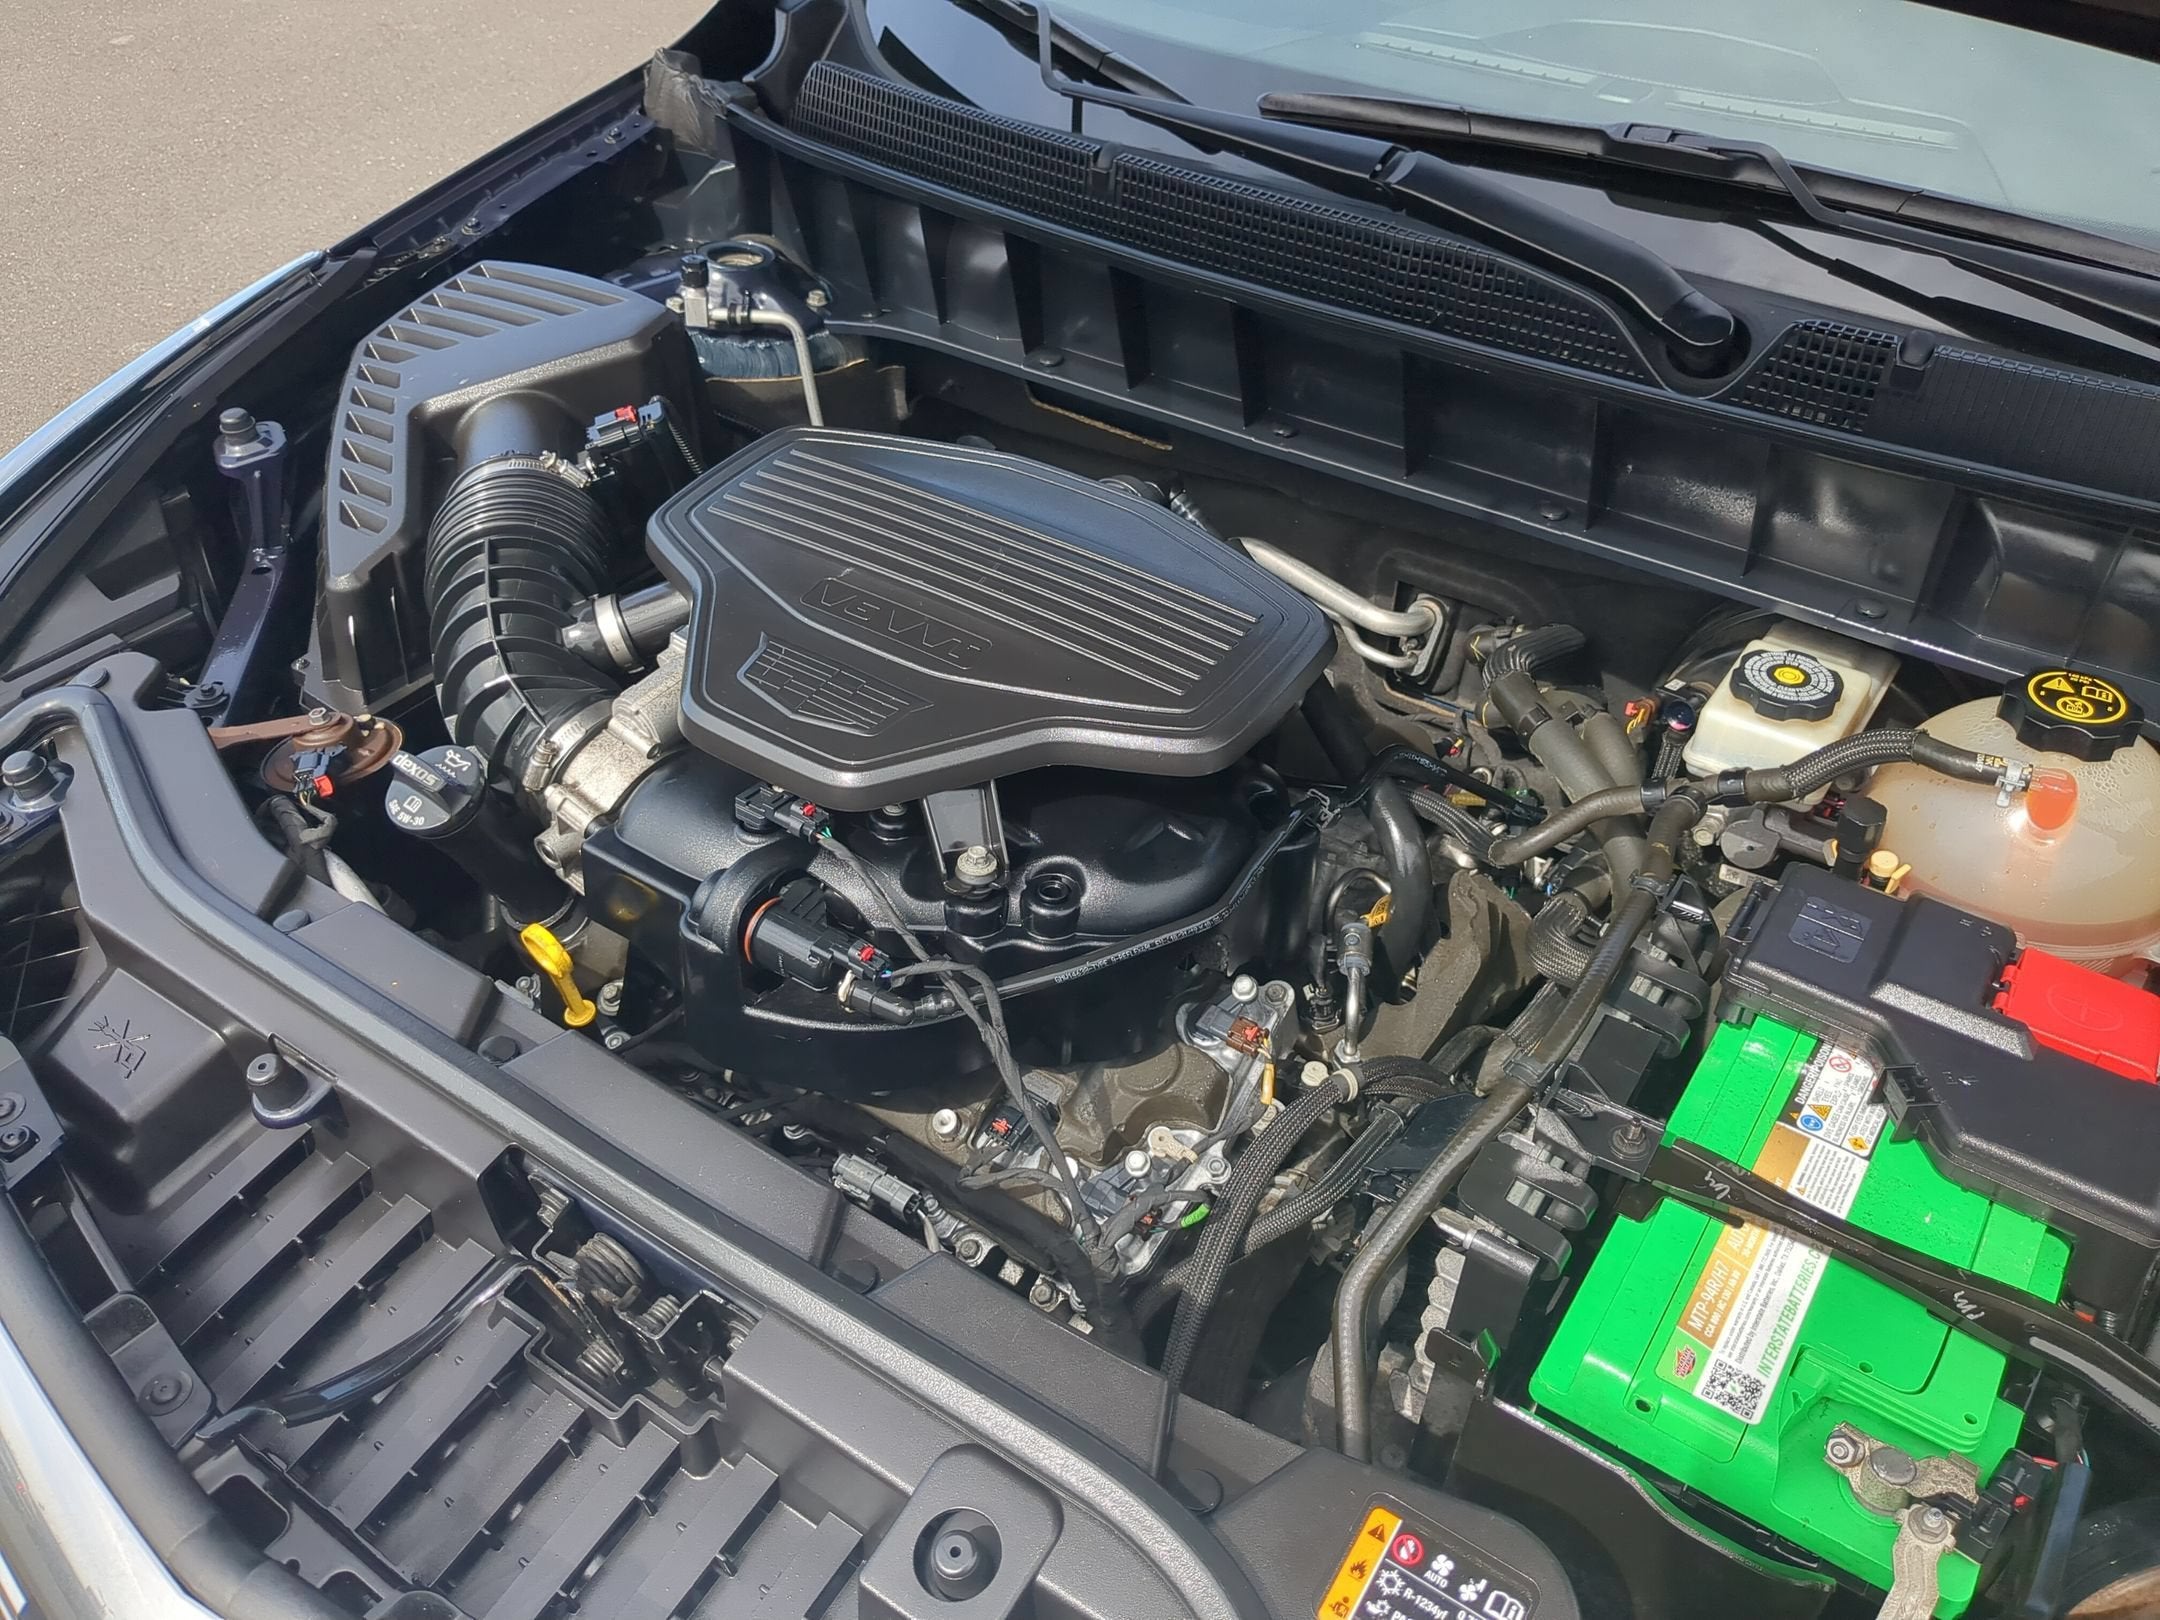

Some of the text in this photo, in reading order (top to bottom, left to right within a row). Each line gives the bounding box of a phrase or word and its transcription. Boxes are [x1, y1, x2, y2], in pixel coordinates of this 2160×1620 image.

[392, 754, 439, 786] dexos
[397, 811, 425, 825] 5W-30
[1794, 1041, 1834, 1105] DANGER/POISON
[1686, 1259, 1729, 1332] MTP-94R/H7
[1746, 1328, 1756, 1338] by
[1748, 1306, 1765, 1331] Interstate
[1733, 1334, 1753, 1364] Distributed
[1424, 1570, 1448, 1588] AUTO
[1403, 1587, 1448, 1620] R-1234yf
